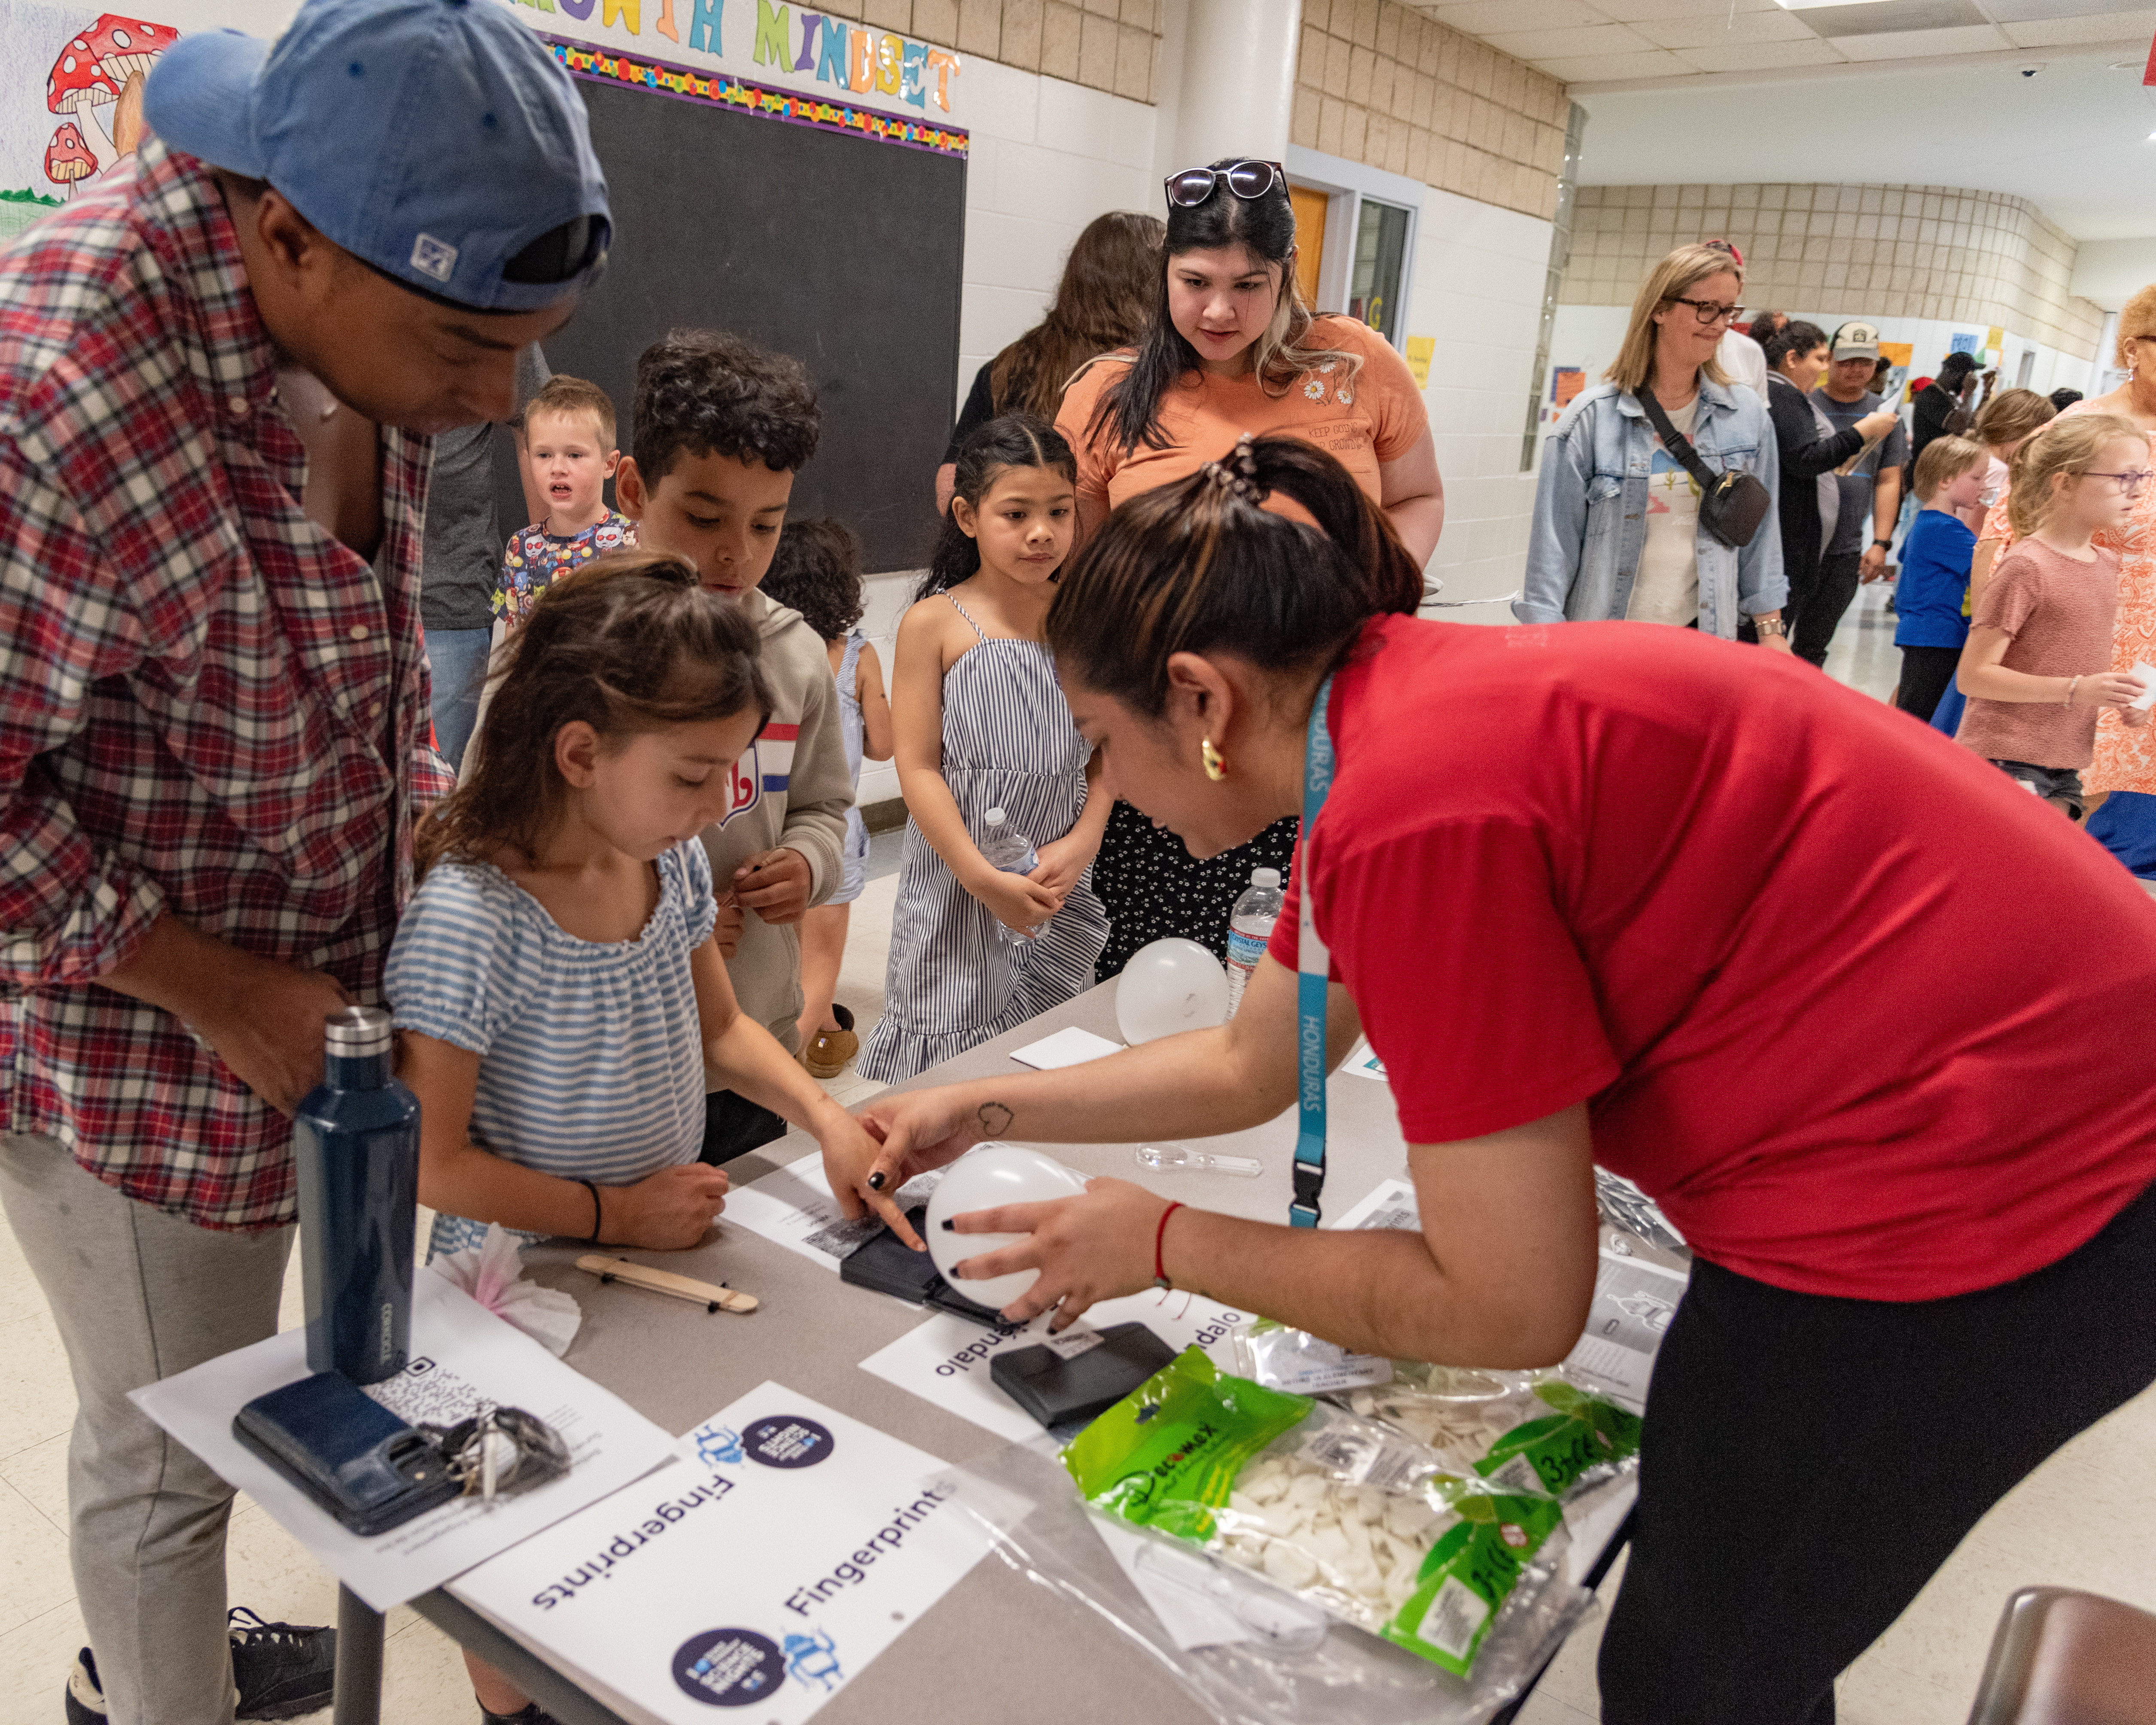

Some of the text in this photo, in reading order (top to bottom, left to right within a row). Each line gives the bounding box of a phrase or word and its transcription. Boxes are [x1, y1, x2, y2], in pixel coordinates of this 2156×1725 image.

[752, 0, 961, 113] MINDSET
[1308, 422, 1358, 439] KEEP GOING
[1232, 934, 1250, 946] CRYSTAL
[1302, 1015, 1322, 1112] HONDURAS
[532, 1474, 736, 1612] Fingerprints
[784, 1478, 961, 1618] Fingerprints
